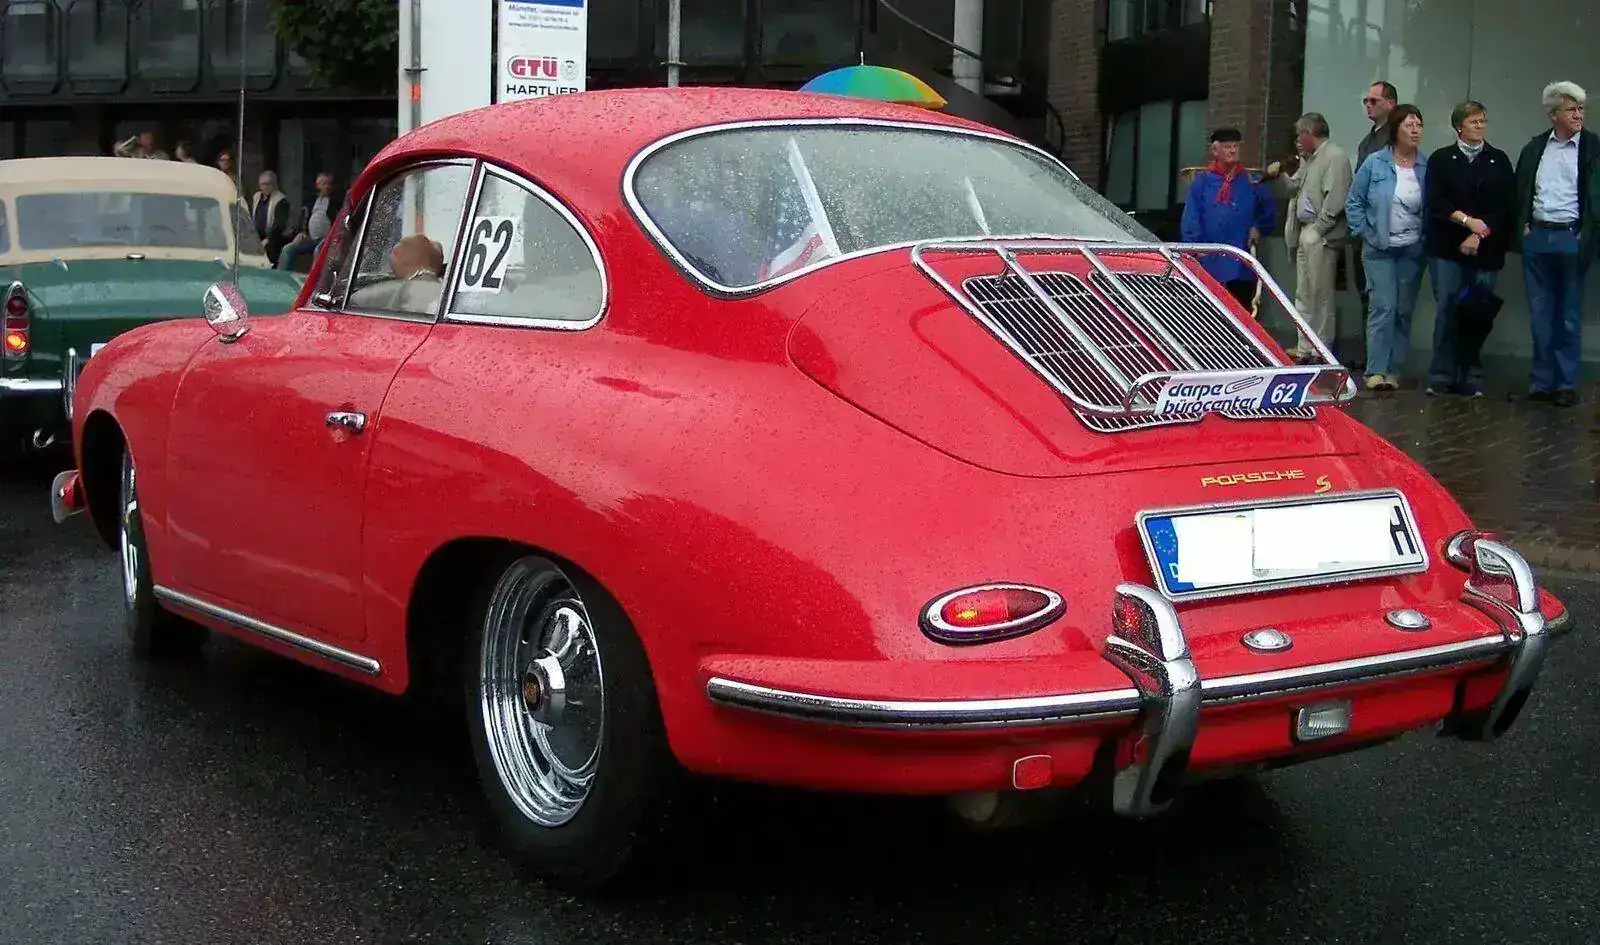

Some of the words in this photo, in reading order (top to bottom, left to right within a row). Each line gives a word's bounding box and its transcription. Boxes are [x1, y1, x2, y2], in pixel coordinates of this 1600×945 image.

[511, 56, 558, 78] GTÜ
[464, 219, 514, 289] 62
[1168, 383, 1223, 401] darpe
[1271, 383, 1298, 404] 62
[1162, 396, 1258, 415] bürocenter
[1200, 469, 1306, 487] PORSCHE
[1314, 475, 1332, 493] S
[1389, 505, 1417, 556] H
